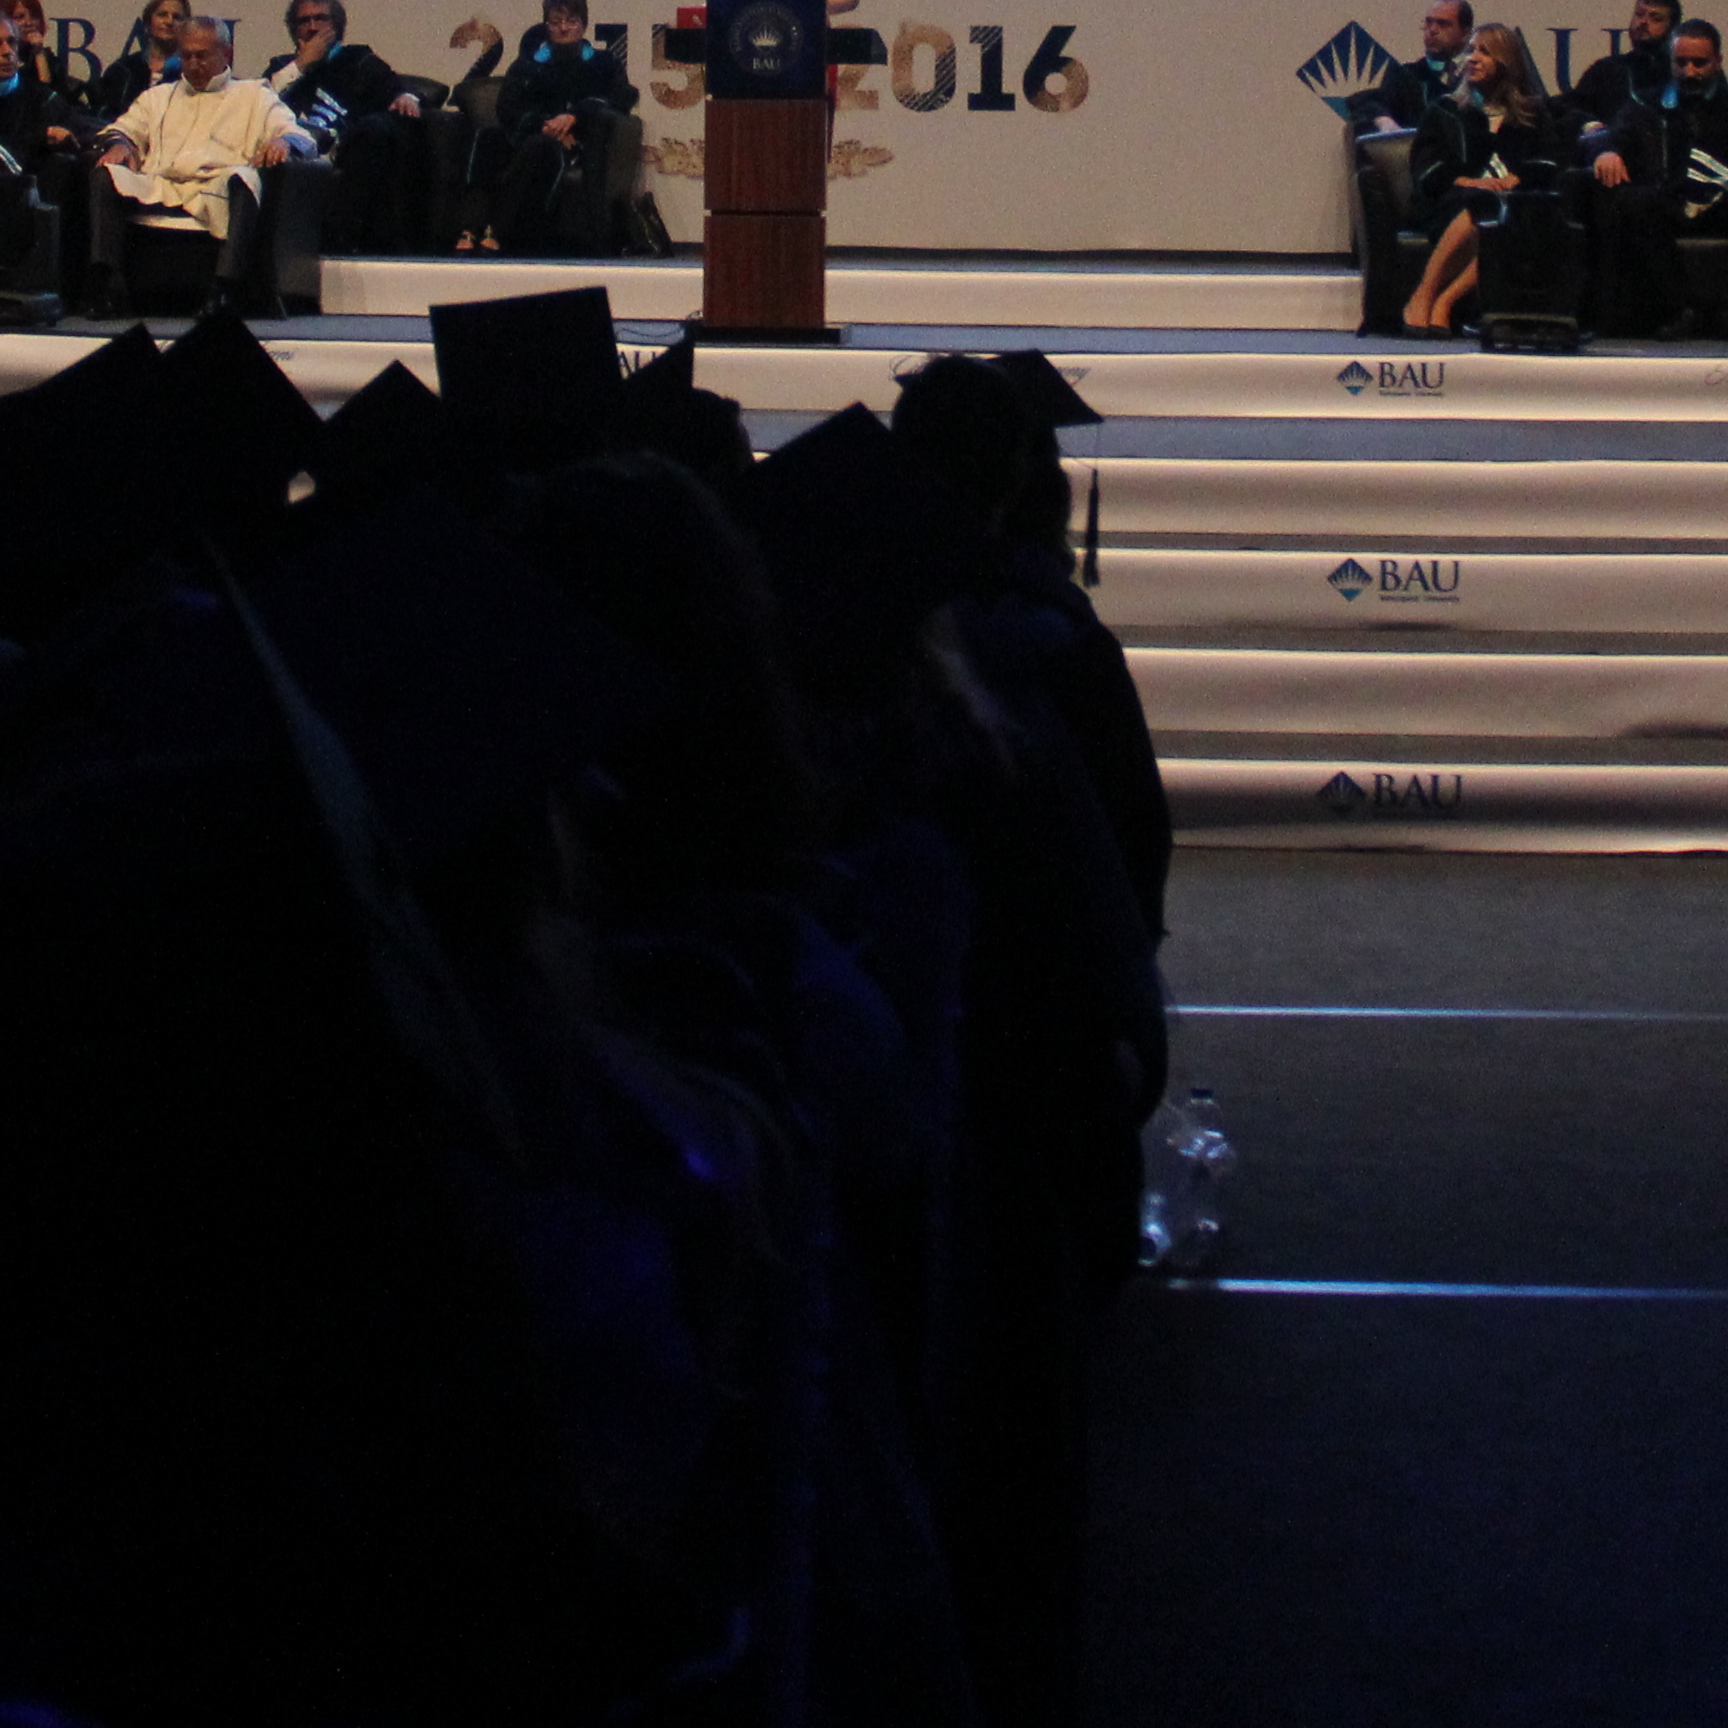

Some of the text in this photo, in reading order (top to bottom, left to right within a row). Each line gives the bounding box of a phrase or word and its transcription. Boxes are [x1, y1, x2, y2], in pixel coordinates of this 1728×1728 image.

[752, 57, 781, 70] BAU
[1377, 360, 1446, 389] BAU
[1379, 559, 1461, 593] BAU
[1373, 773, 1463, 809] BAU
